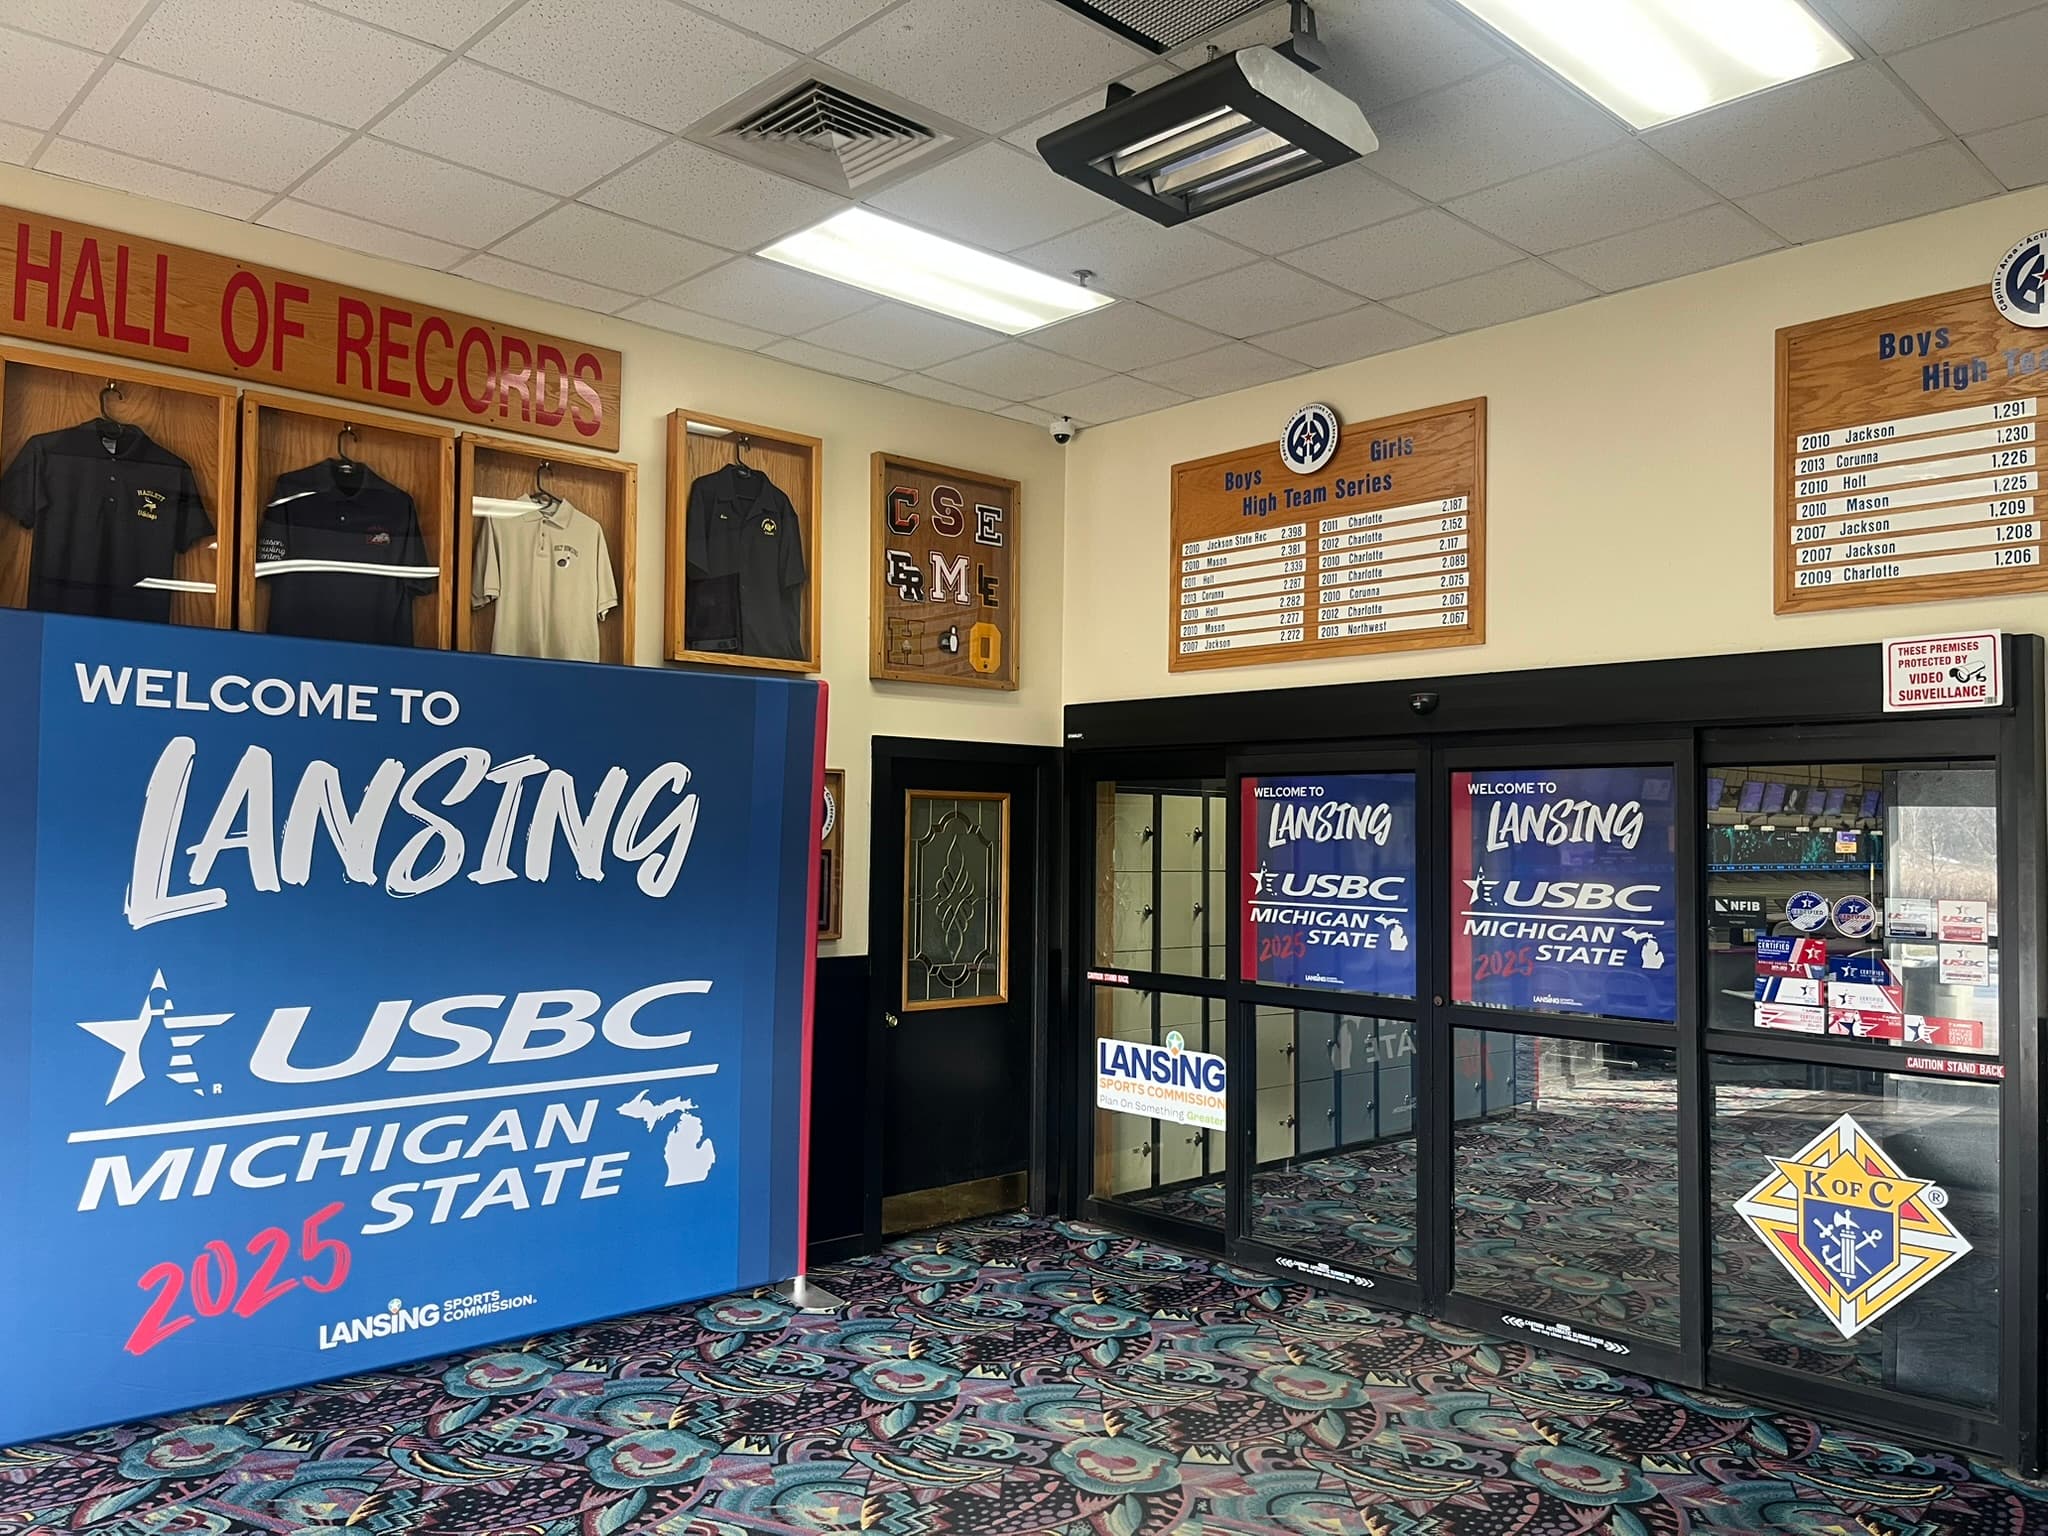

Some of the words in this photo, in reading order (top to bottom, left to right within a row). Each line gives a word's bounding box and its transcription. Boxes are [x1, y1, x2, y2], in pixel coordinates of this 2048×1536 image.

[13, 223, 190, 353] HALL
[220, 272, 310, 372] OF
[336, 296, 603, 438] RECORDS
[1879, 327, 1949, 360] Boys
[1922, 355, 1988, 391] High
[2003, 348, 2048, 377] Tea
[1370, 436, 1414, 462] Girls
[1802, 434, 1830, 451] 2010
[1845, 426, 1895, 444] Jackson
[1800, 457, 1825, 474] 2013
[1836, 452, 1878, 468] Corunna
[1224, 470, 1262, 491] Boys
[1800, 479, 1828, 495] 2010
[1843, 474, 1866, 489] Holt
[1243, 492, 1277, 516] High
[1284, 485, 1327, 508] Team
[1335, 473, 1392, 499] Series
[887, 486, 919, 535] C
[931, 485, 964, 537] S
[1802, 502, 1826, 518] 2010
[1847, 496, 1889, 512] Mason
[975, 504, 1002, 546] E
[1322, 520, 1338, 532] 2011
[1348, 513, 1383, 528] Charlotte
[1796, 525, 1826, 541] 2007
[1839, 519, 1889, 536] Jackson
[1185, 544, 1200, 555] 2010
[1207, 539, 1233, 551] Jackson
[1235, 535, 1252, 546] State
[1322, 537, 1339, 550] 2012
[1348, 532, 1383, 546] Charlotte
[1322, 555, 1340, 568] 2010
[1348, 550, 1383, 565] Charlotte
[1802, 547, 1832, 563] 2007
[1845, 542, 1895, 558] Jackson
[1184, 560, 1200, 571] 2010
[1207, 557, 1227, 567] Mason
[1800, 569, 1832, 586] 2009
[1844, 564, 1899, 581] Charlotte
[929, 551, 970, 605] M
[1322, 573, 1338, 585] 2011
[1348, 568, 1383, 581] Charlotte
[1183, 593, 1197, 604] 2013
[1201, 590, 1224, 601] Corunna
[1322, 590, 1341, 602] 2010
[1349, 587, 1380, 599] Corunna
[1321, 608, 1339, 620] 2012
[1348, 604, 1383, 617] Charlotte
[1183, 625, 1198, 636] 2010
[1205, 623, 1225, 633] Mason
[1321, 626, 1339, 637] 2013
[1348, 621, 1387, 635] Northwest
[969, 622, 1001, 674] O
[1183, 641, 1198, 652] 2007
[1204, 639, 1231, 650] Jackson
[1898, 645, 1927, 656] THESE
[1929, 641, 1979, 654] PREMISES
[1898, 656, 1951, 669] PROTECTED
[1955, 654, 1968, 664] BY
[1909, 671, 1943, 685] VIDEO
[74, 661, 379, 722] WELCOME
[391, 687, 461, 727] TO
[1898, 685, 1986, 701] SURVEILLANCE
[1254, 786, 1307, 798] WELCOME
[1309, 786, 1324, 797] TO
[1468, 782, 1534, 795] WELCOME
[1537, 782, 1557, 794] TO
[123, 735, 701, 930] LANSING
[1268, 801, 1392, 849] LANSING
[1487, 799, 1644, 852] LANSING
[1281, 873, 1406, 901] USBC
[1503, 881, 1661, 912] USBC
[1730, 900, 1760, 911] NFIB
[1250, 907, 1369, 929] MICHIGAN
[1942, 915, 1984, 923] USBC
[1307, 930, 1379, 948] STATE
[1463, 919, 1615, 944] MICHIGAN
[1260, 931, 1306, 962] 2025
[1535, 944, 1628, 967] STATE
[1757, 942, 1790, 950] CERTIFIED
[1474, 946, 1533, 981] 2025
[1943, 959, 1985, 967] USBC
[249, 980, 713, 1085] USBC
[1907, 1057, 1944, 1071] CAUTION
[1946, 1060, 1976, 1074] STAND
[1979, 1063, 2005, 1078] BACK
[1099, 1077, 1145, 1095] SPORTS
[1147, 1086, 1225, 1111] COMMISSION
[1100, 1095, 1119, 1105] Plan
[1120, 1098, 1133, 1109] On
[1135, 1101, 1184, 1122] Something
[1186, 1111, 1225, 1126] Greater
[77, 1099, 600, 1212] MICHIGAN
[361, 1150, 630, 1236] STATE
[1803, 1169, 1828, 1198] K
[1869, 1180, 1894, 1208] C
[123, 1201, 352, 1356] 2025
[443, 1290, 500, 1312] SPORTS
